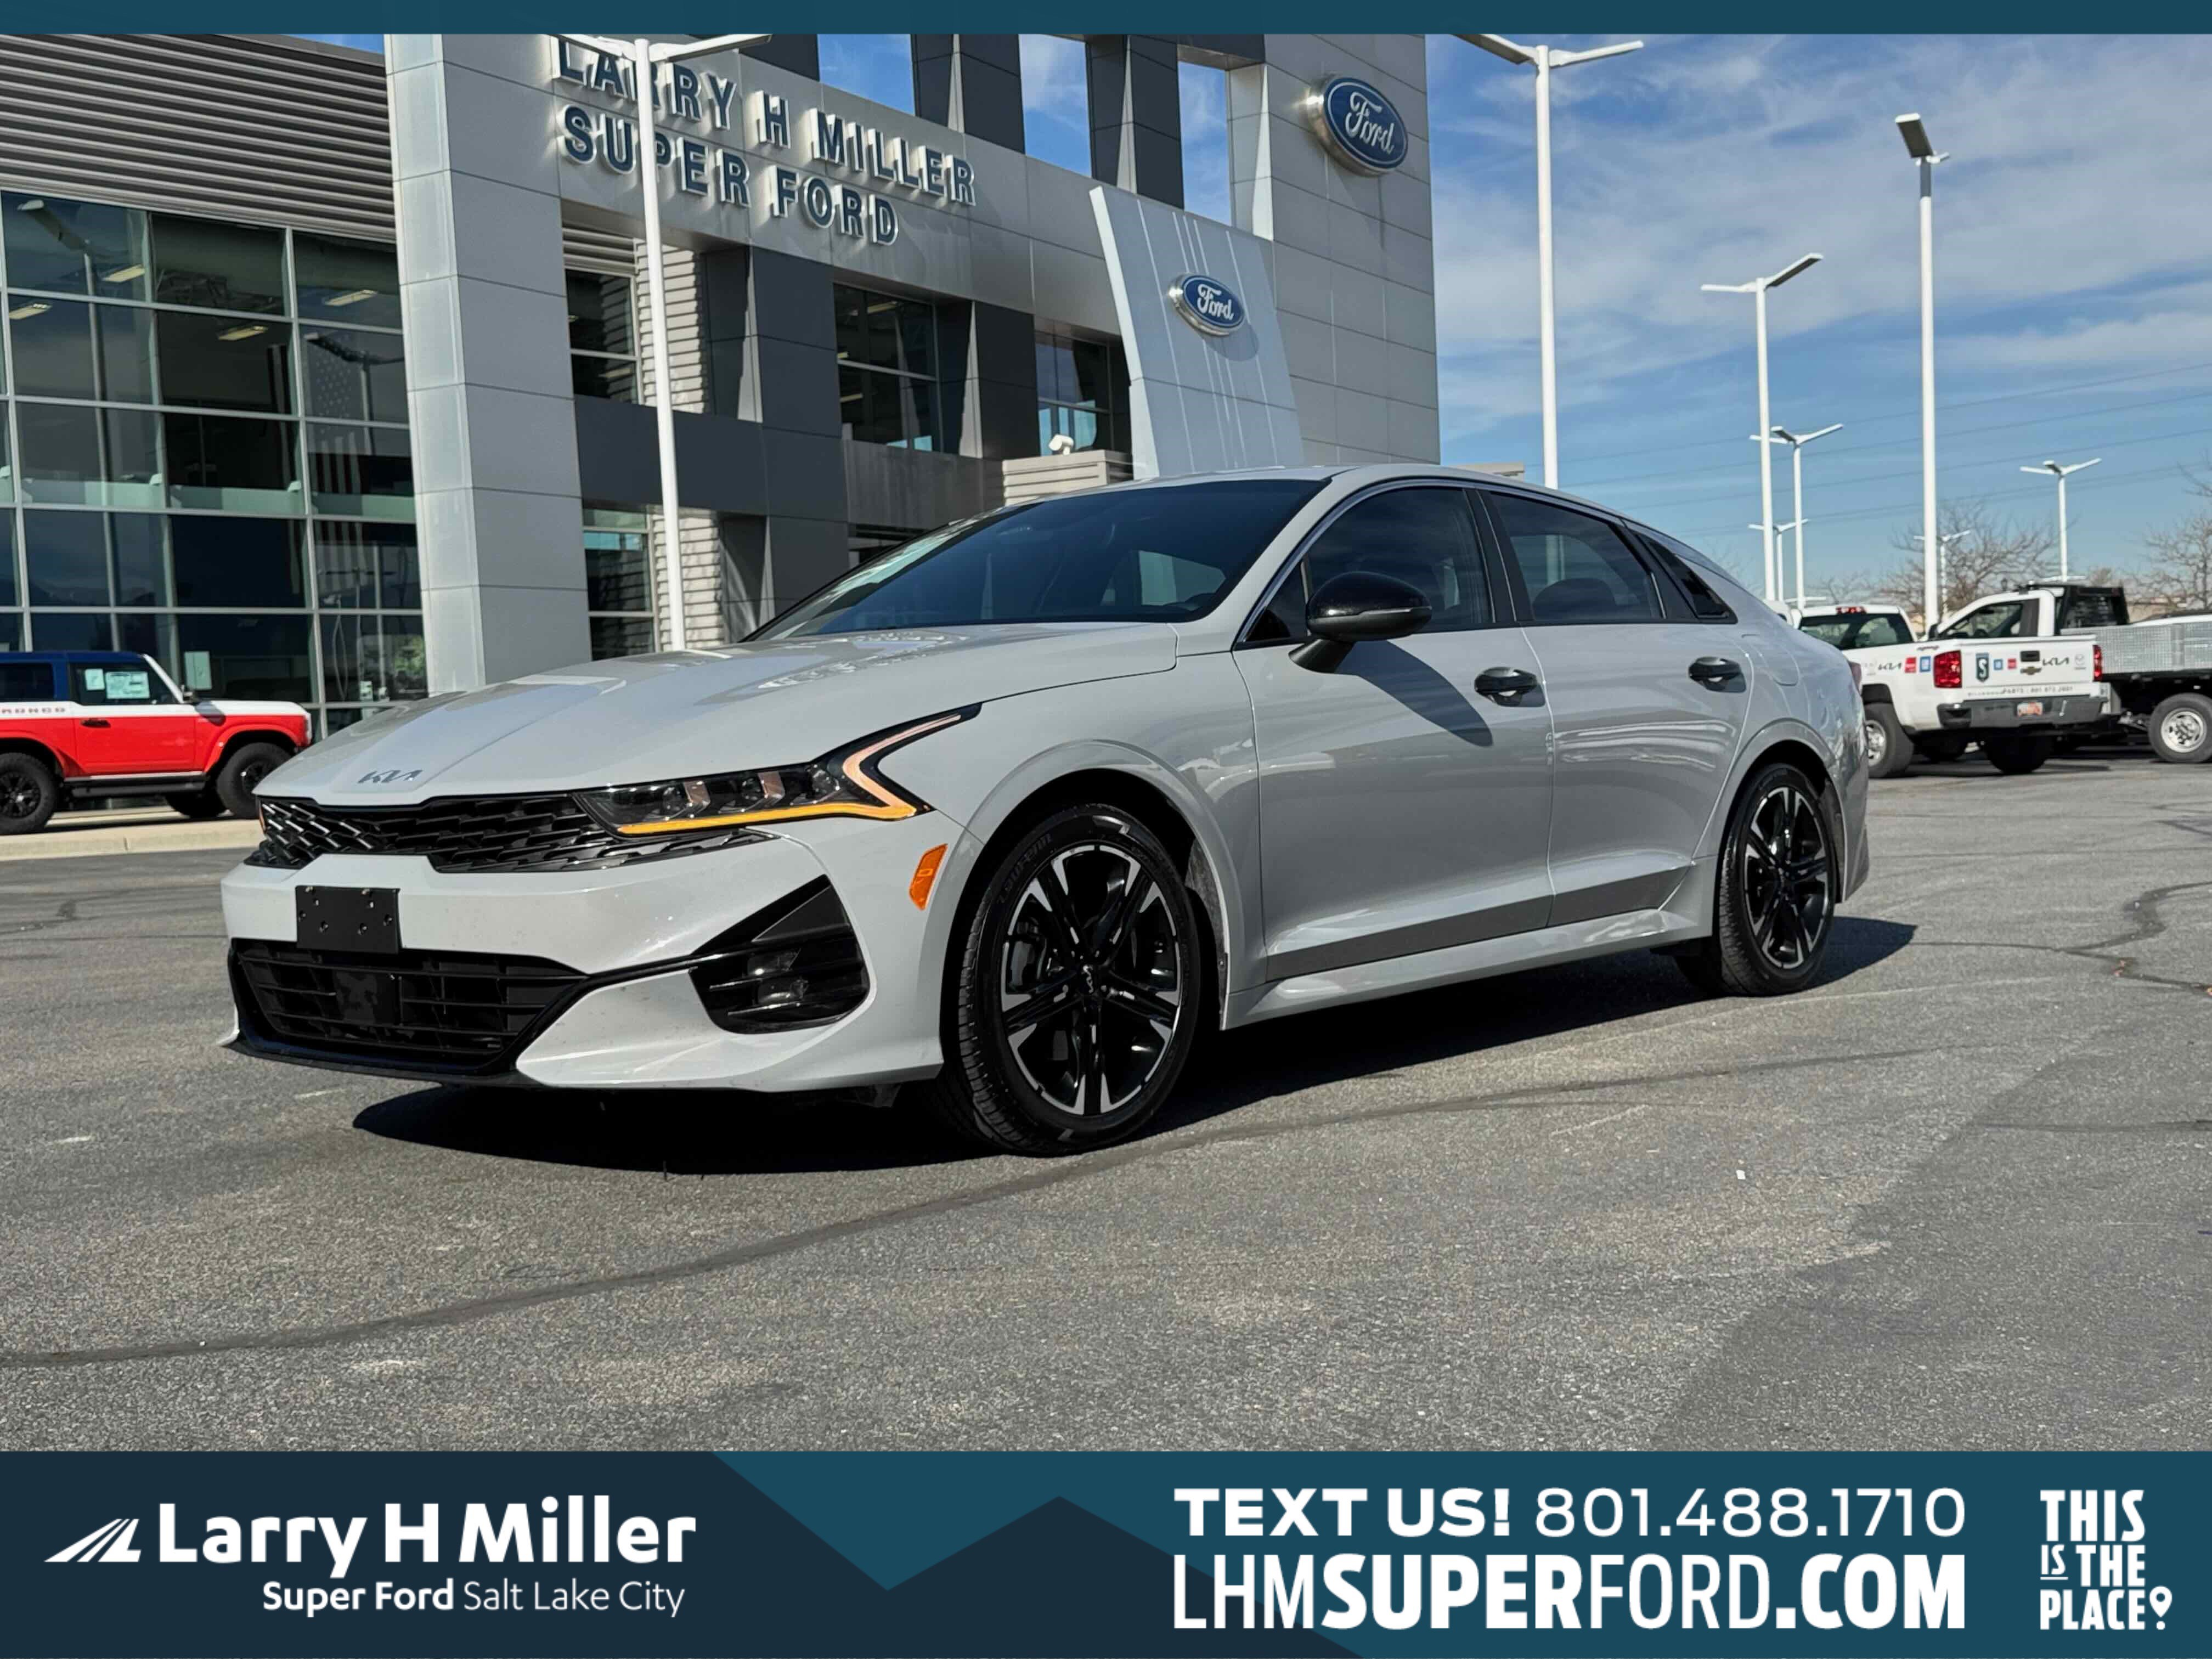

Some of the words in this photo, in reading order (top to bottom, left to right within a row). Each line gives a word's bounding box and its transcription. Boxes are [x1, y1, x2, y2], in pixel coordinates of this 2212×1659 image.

[757, 90, 791, 149] H
[810, 108, 976, 205] MILLER
[1345, 91, 1395, 154] Ford
[557, 105, 751, 207] SUPER
[769, 164, 899, 245] FORD
[1197, 284, 1234, 320] Ford
[357, 769, 423, 784] KIA
